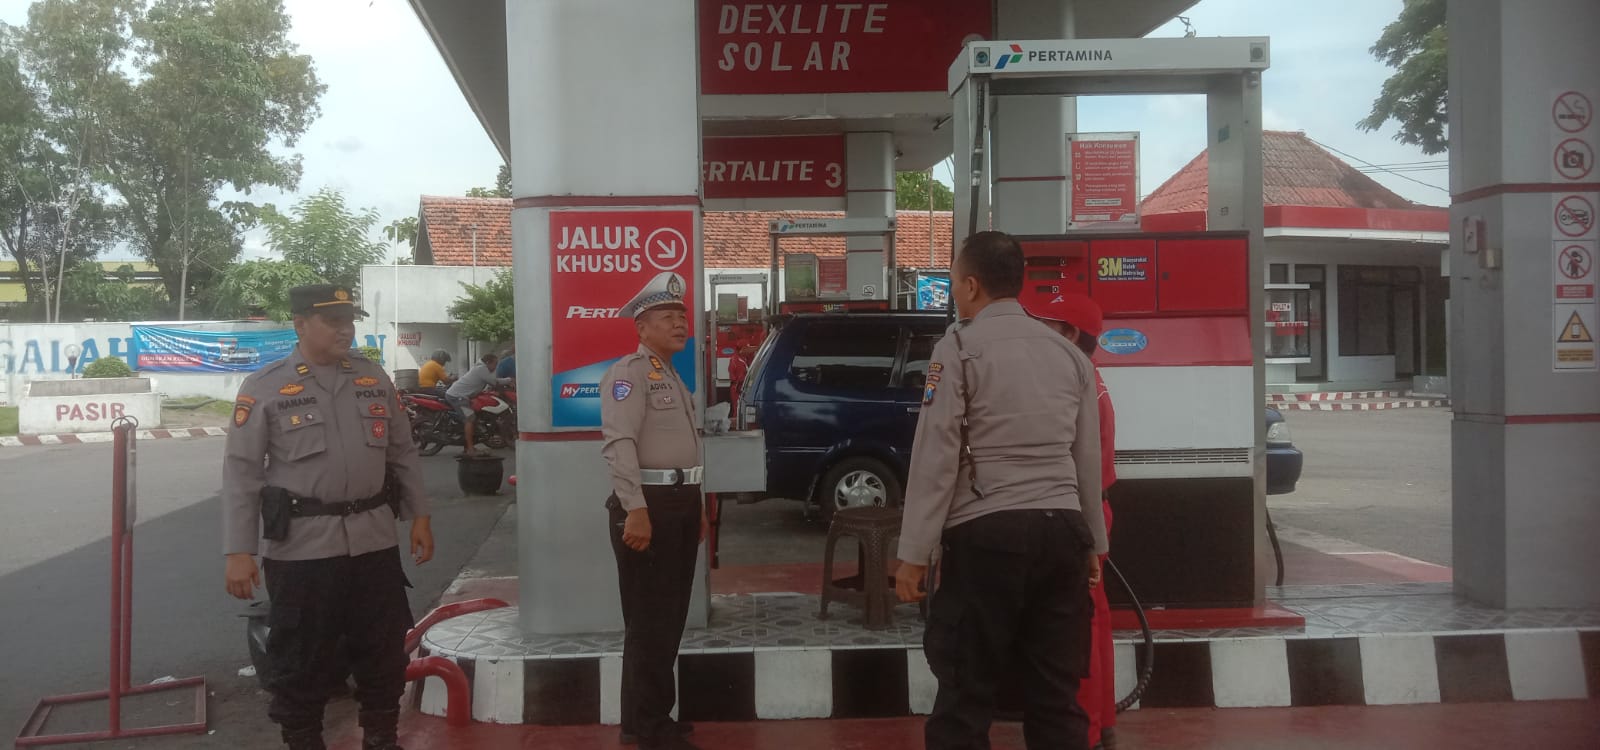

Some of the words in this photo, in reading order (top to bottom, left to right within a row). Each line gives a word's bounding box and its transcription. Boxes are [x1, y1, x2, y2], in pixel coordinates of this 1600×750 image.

[718, 3, 888, 35] DEXLITE
[718, 41, 850, 71] SOLAR
[1028, 49, 1113, 63] PERTAMINA
[825, 162, 842, 189] 3
[557, 226, 641, 250] JALUR
[557, 254, 642, 273] KHUSUS
[1098, 257, 1122, 277] 3M
[356, 388, 387, 399] POLRI
[562, 386, 600, 397] MyPERT
[56, 402, 125, 422] PASIR
